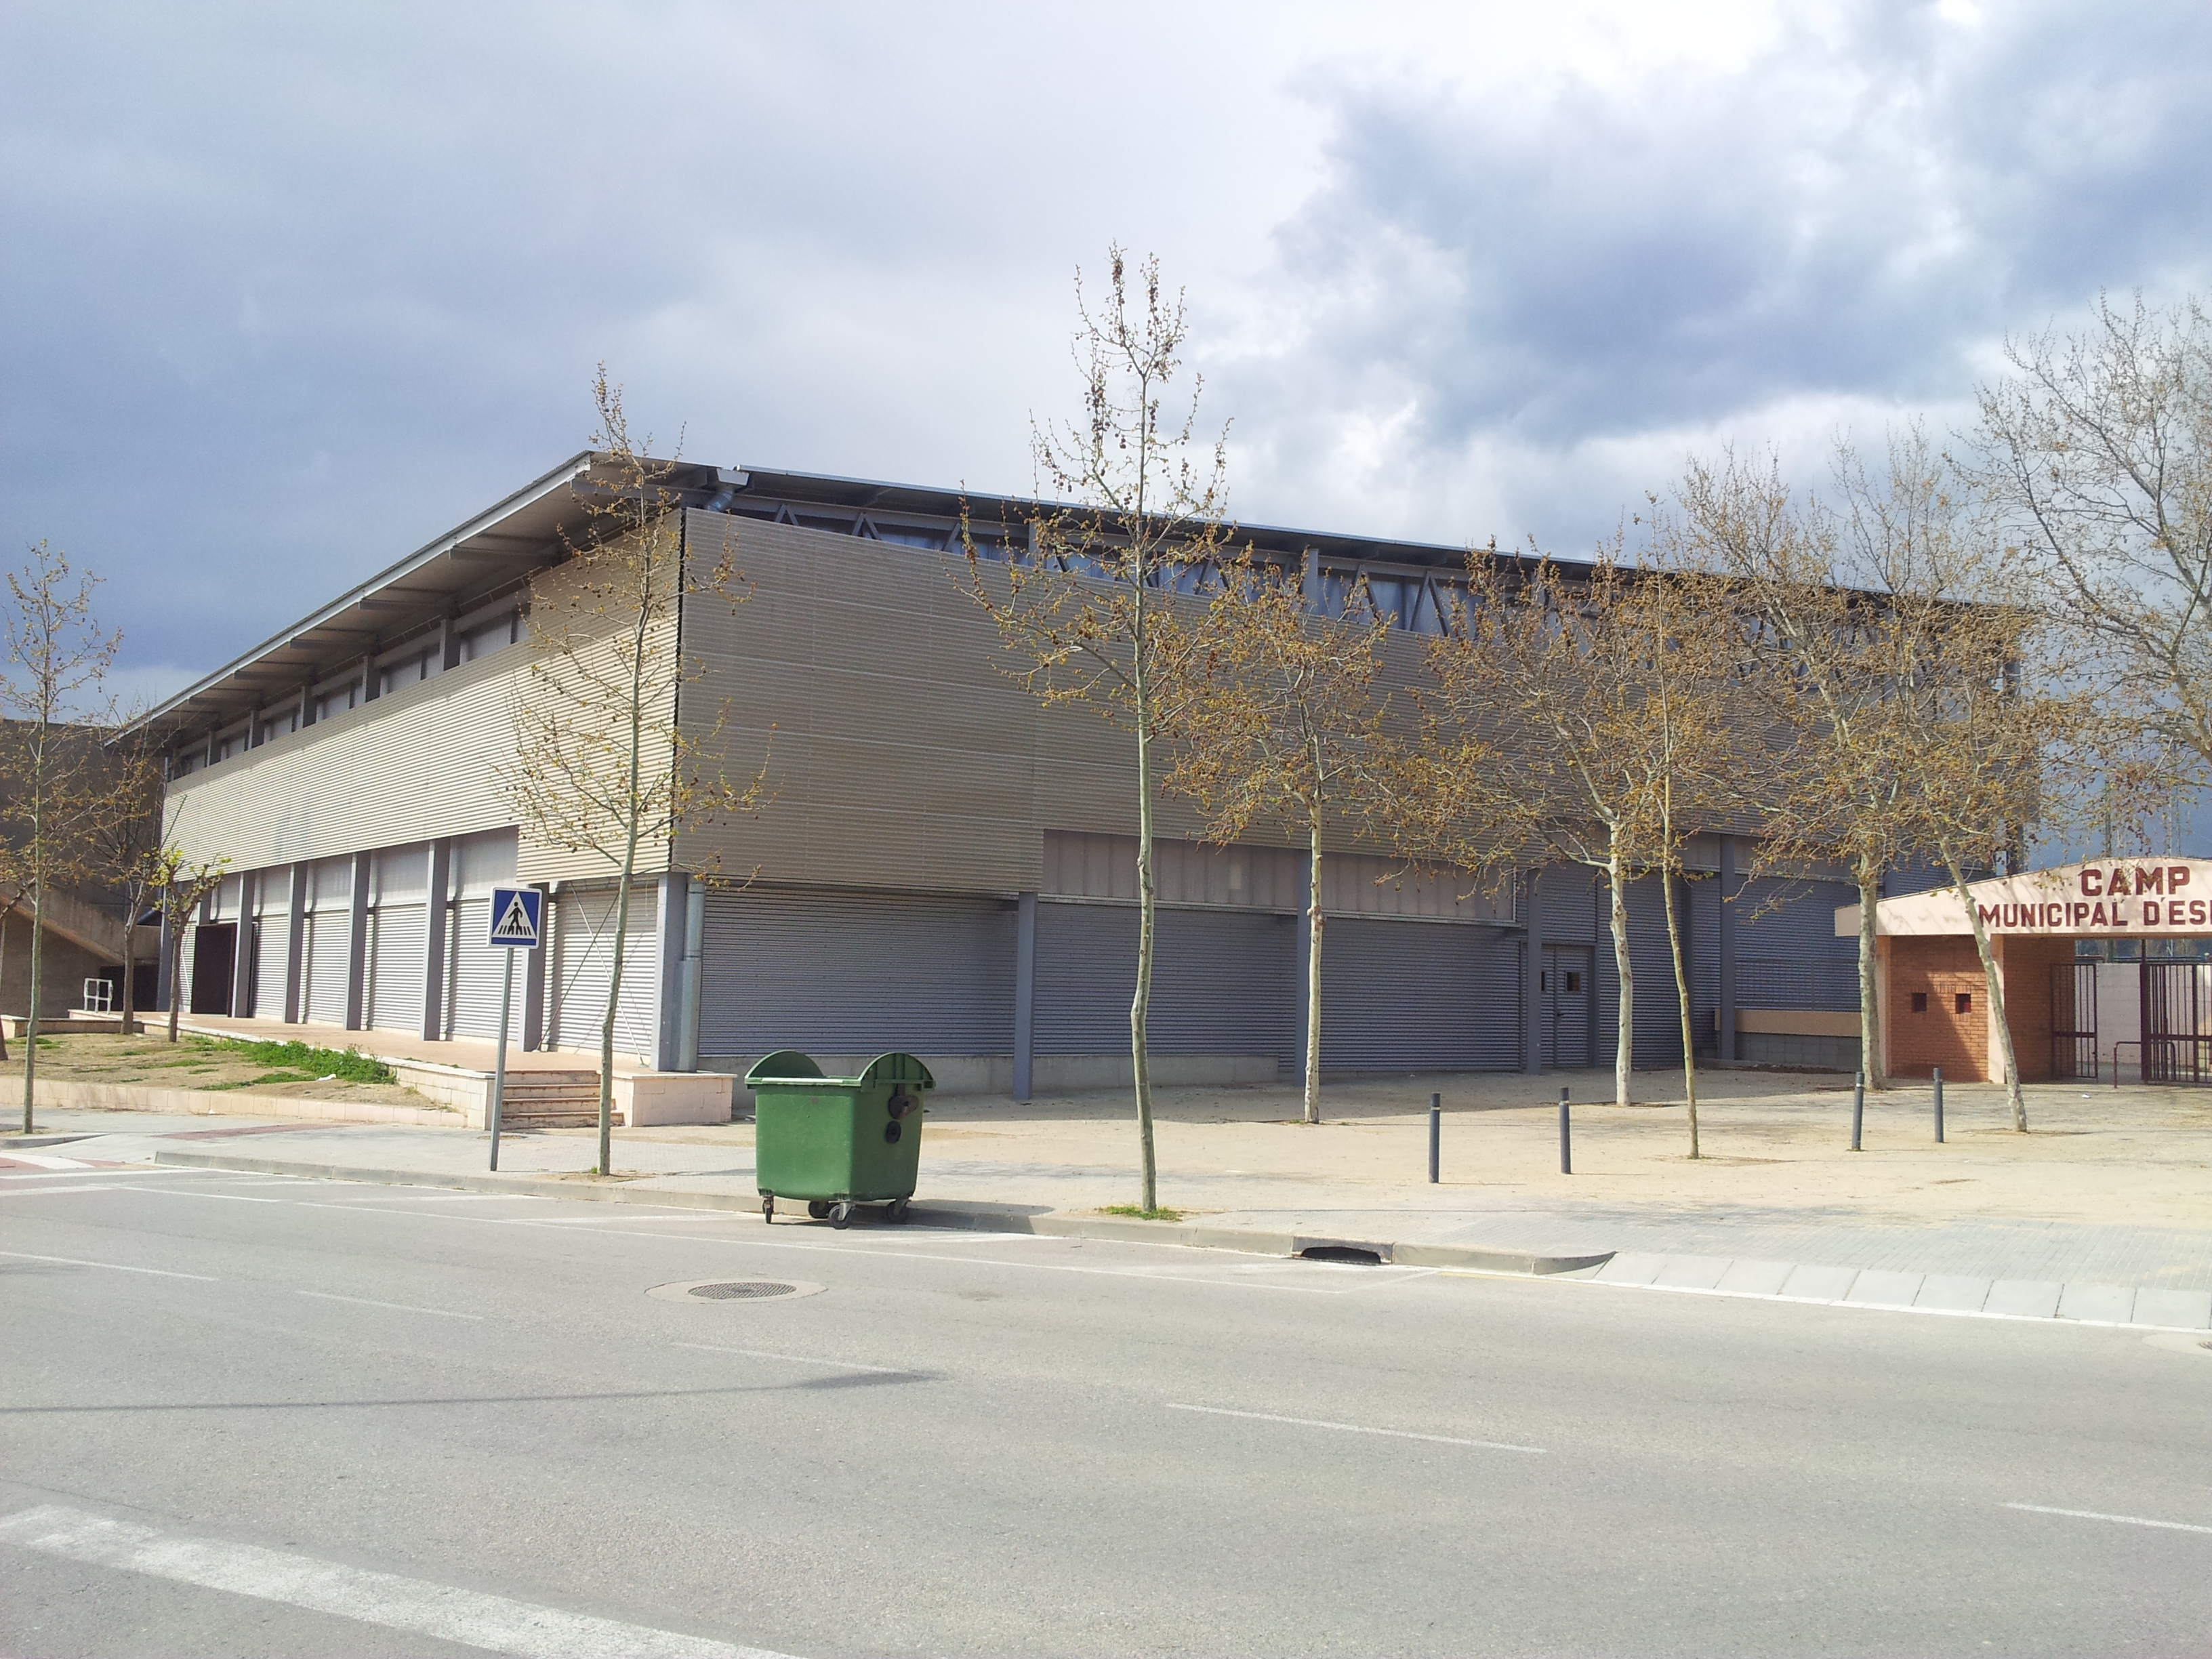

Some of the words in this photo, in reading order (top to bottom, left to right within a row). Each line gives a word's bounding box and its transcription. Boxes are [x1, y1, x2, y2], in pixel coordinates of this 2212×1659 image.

[2081, 866, 2190, 896] CAMP
[1978, 901, 2129, 928] MUNICIPAL
[2143, 897, 2212, 926] D'ES
